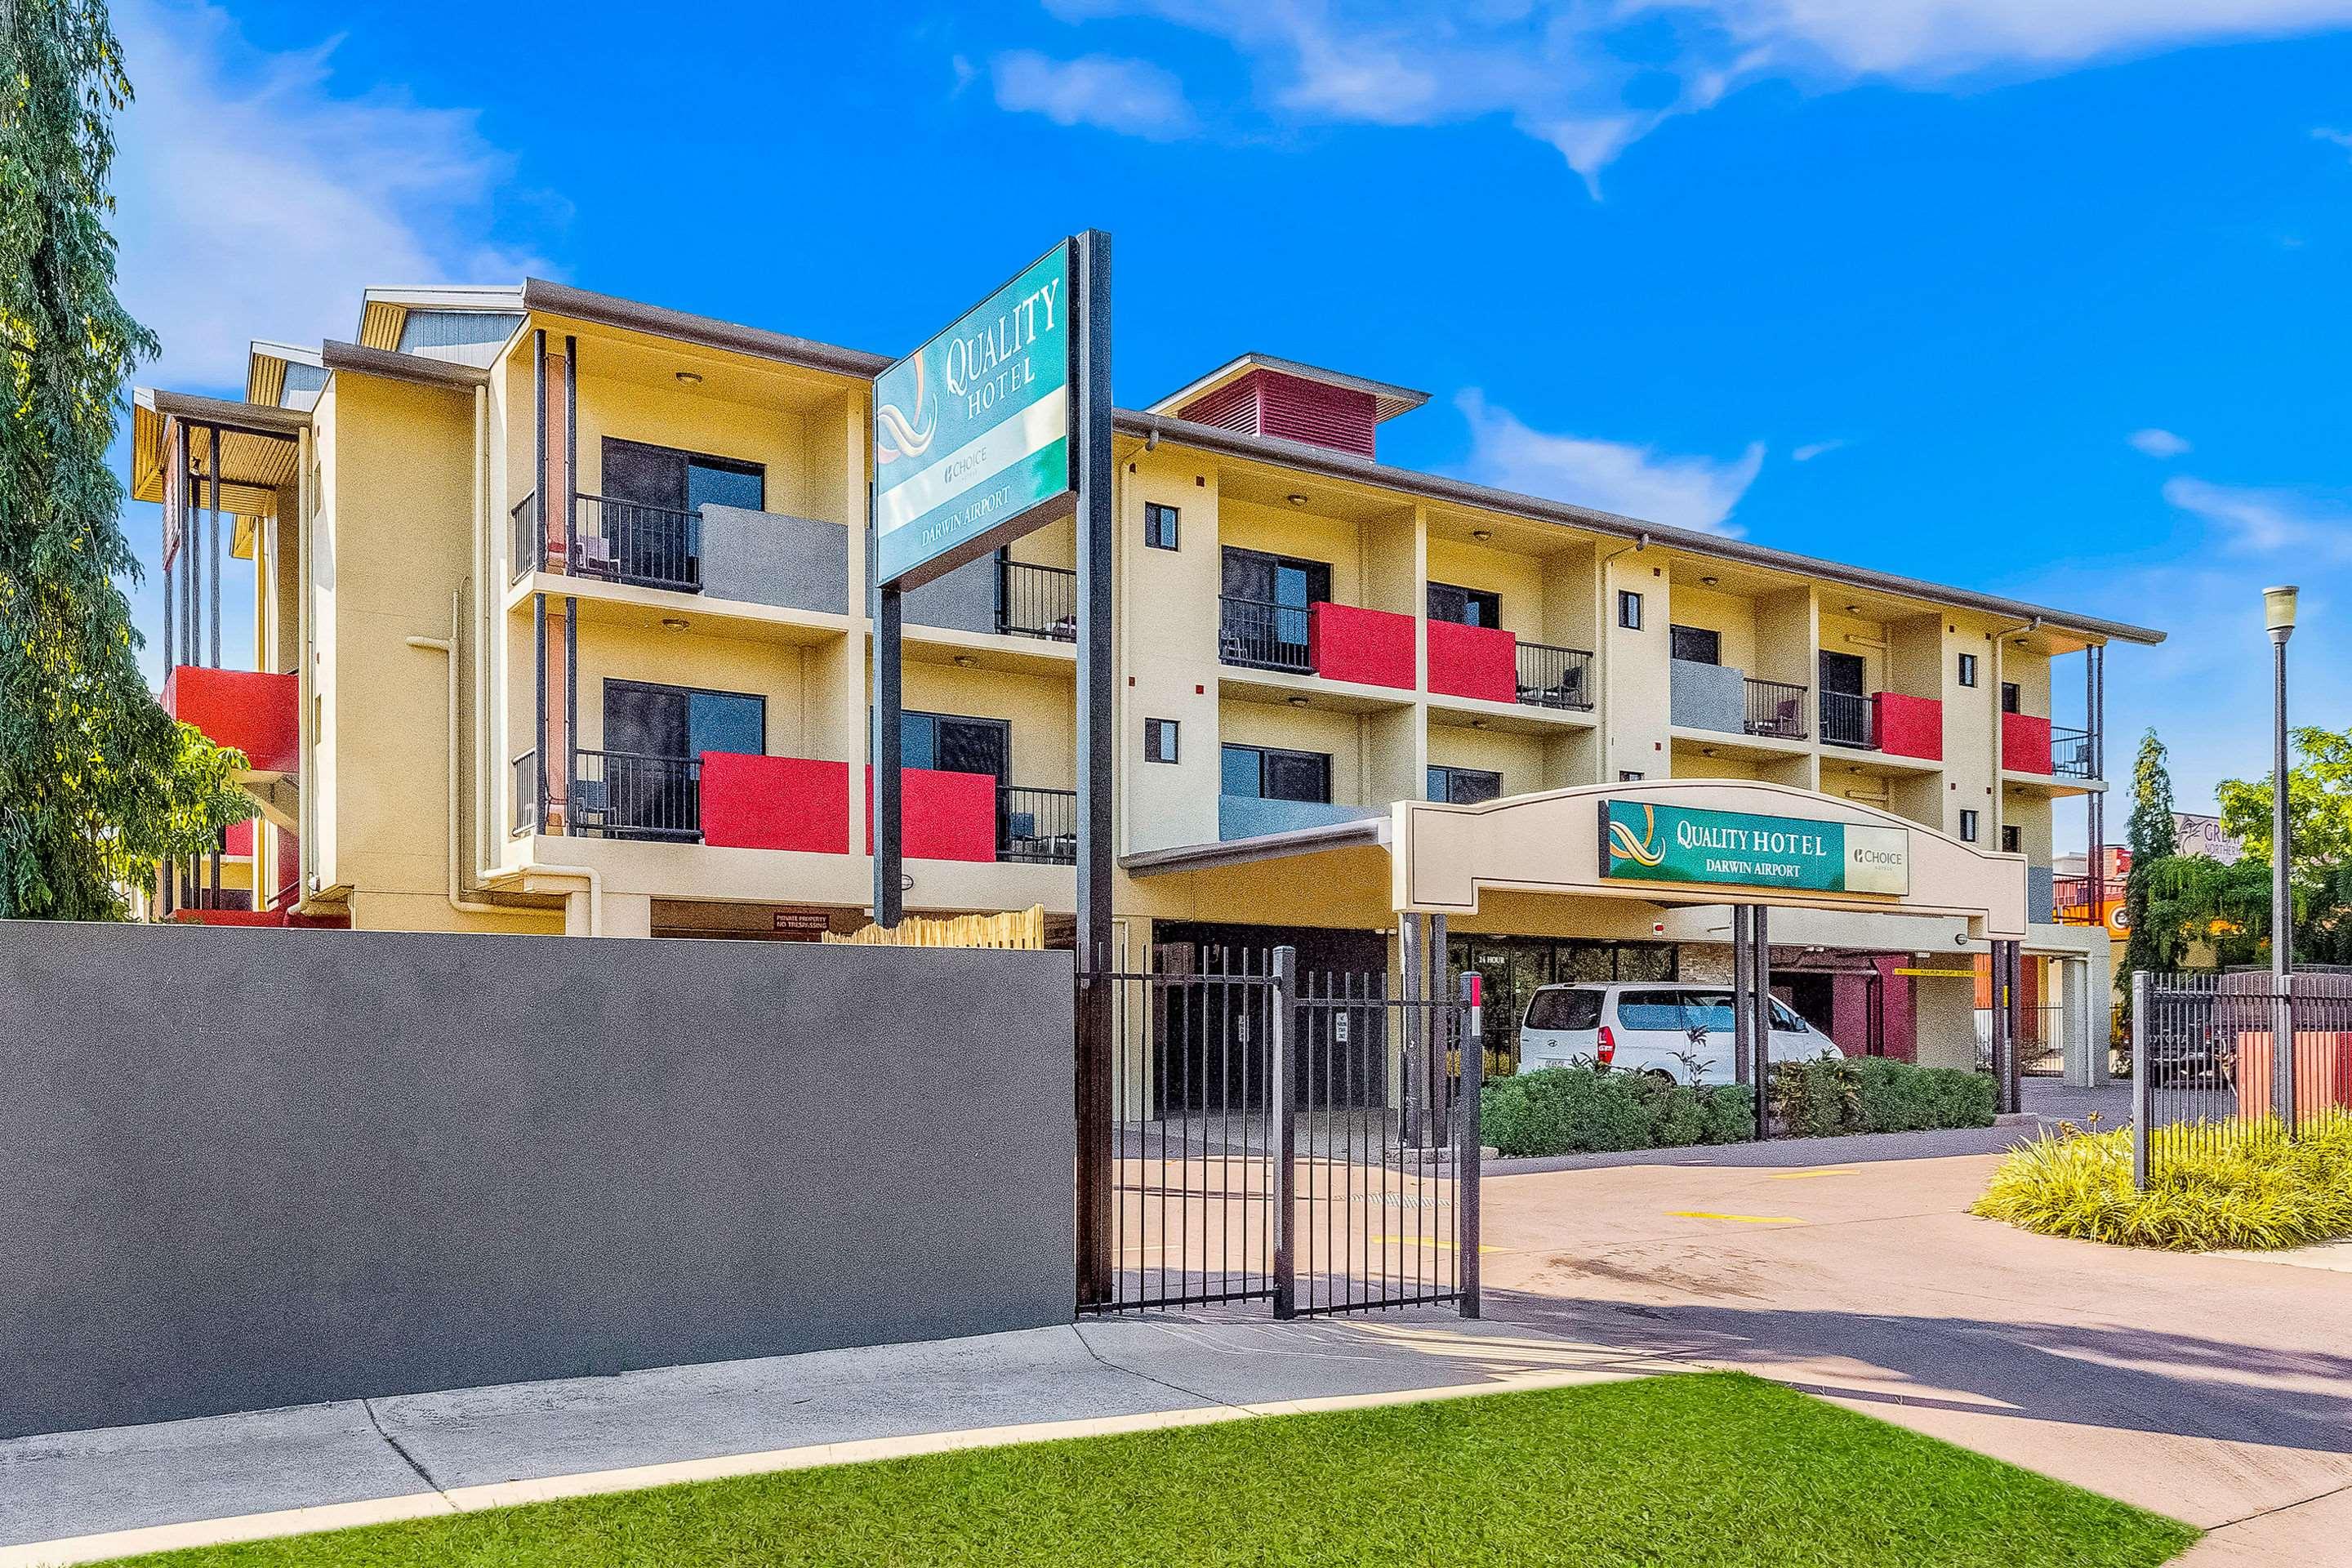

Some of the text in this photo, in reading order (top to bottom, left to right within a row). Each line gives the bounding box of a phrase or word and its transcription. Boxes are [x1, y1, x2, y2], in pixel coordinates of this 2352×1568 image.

[947, 278, 1059, 397] QUALITY
[968, 357, 1036, 420] HOTEL
[953, 447, 987, 477] CHOICE
[921, 486, 1010, 547] DARWIN AIRPORT
[1677, 820, 1827, 856] QUALITY HOTEL
[1706, 858, 1801, 878] DARWIN AIRPORT
[1864, 850, 1902, 865] CHOICE
